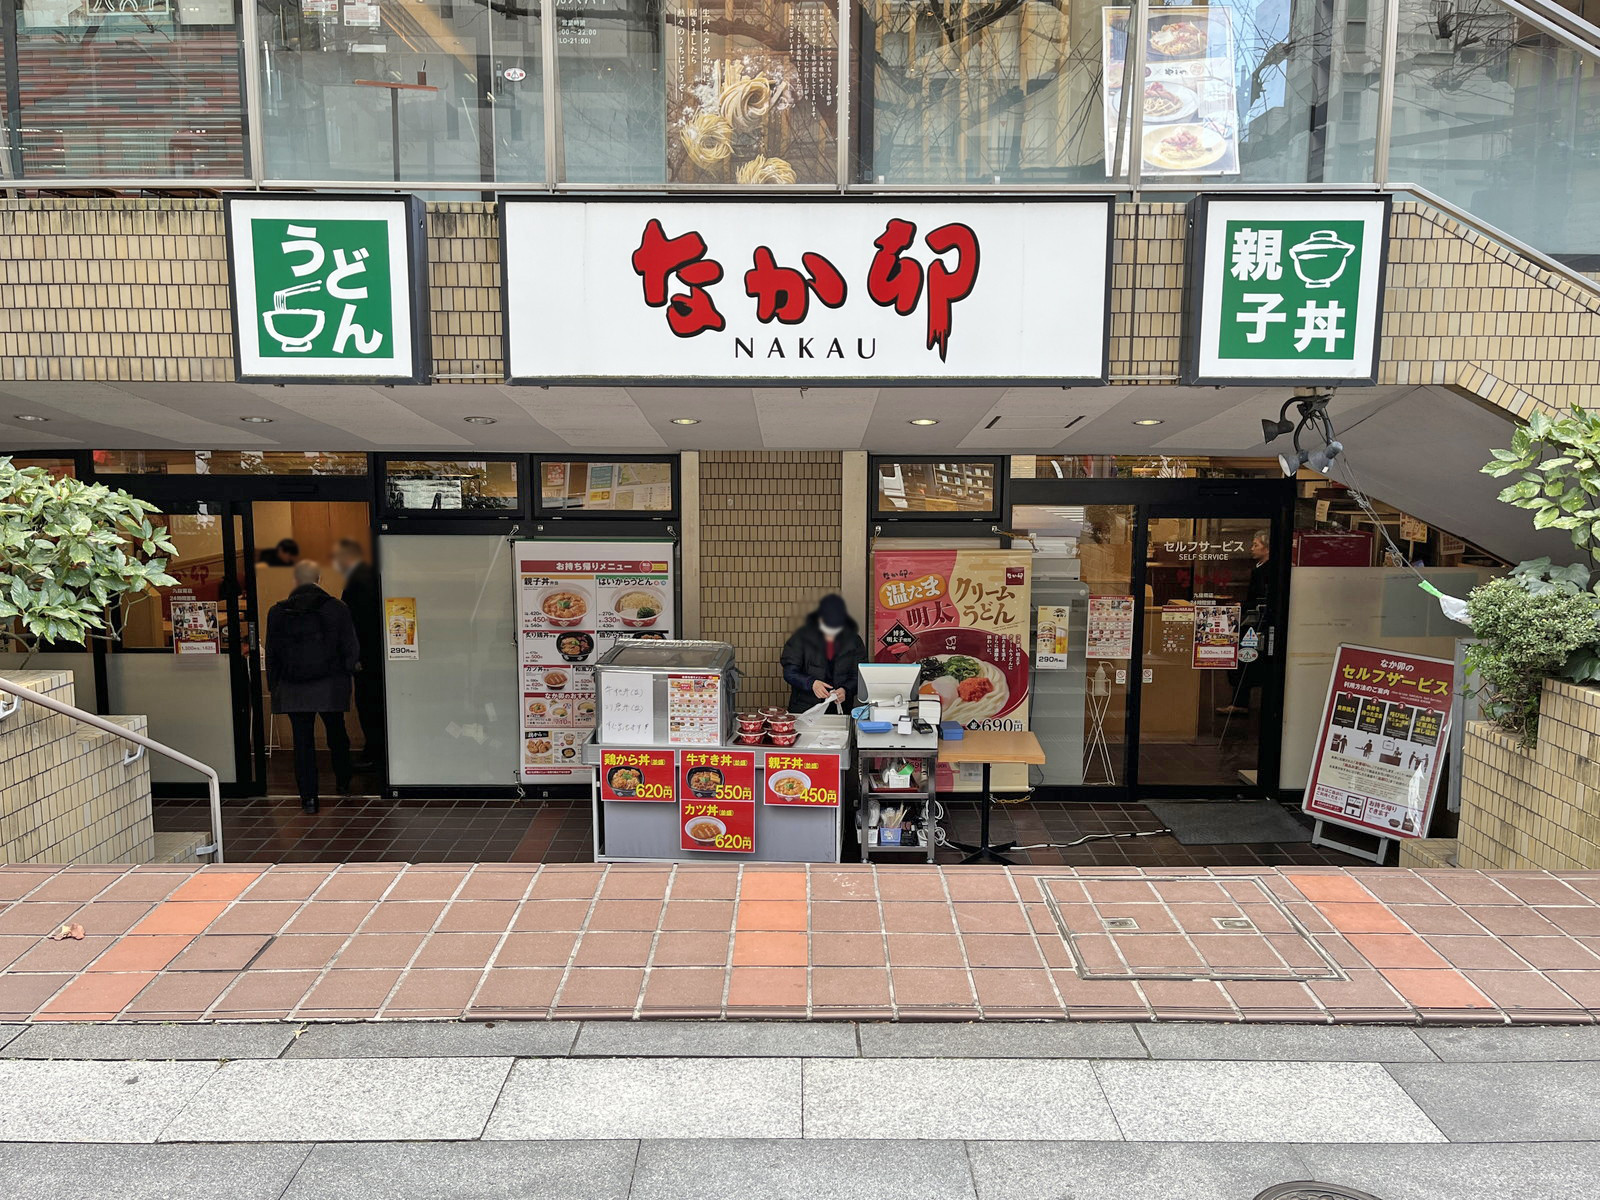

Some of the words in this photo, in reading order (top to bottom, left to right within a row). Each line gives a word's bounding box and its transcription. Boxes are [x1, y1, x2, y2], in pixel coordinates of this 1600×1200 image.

[281, 224, 384, 354] うどん
[632, 218, 980, 363] なか卯
[1231, 228, 1346, 353] 親子丼
[734, 337, 876, 359] NAKAU
[1163, 541, 1245, 552] セルフサービス
[556, 562, 632, 571] お持ち帰りメニュー
[1179, 553, 1197, 561] SELF
[1198, 553, 1229, 561] SERVICE
[598, 577, 653, 586] はいからうどん
[885, 575, 941, 606] 温たま
[955, 577, 1016, 604] クリーム
[906, 601, 956, 630] 明太
[963, 601, 1016, 627] うどん
[1380, 659, 1415, 672] なか卯の
[1342, 664, 1449, 696] セルフサービス
[636, 783, 673, 799] 620円
[715, 784, 752, 800] 550円
[800, 787, 837, 804] 450円
[715, 833, 752, 850] 620円
